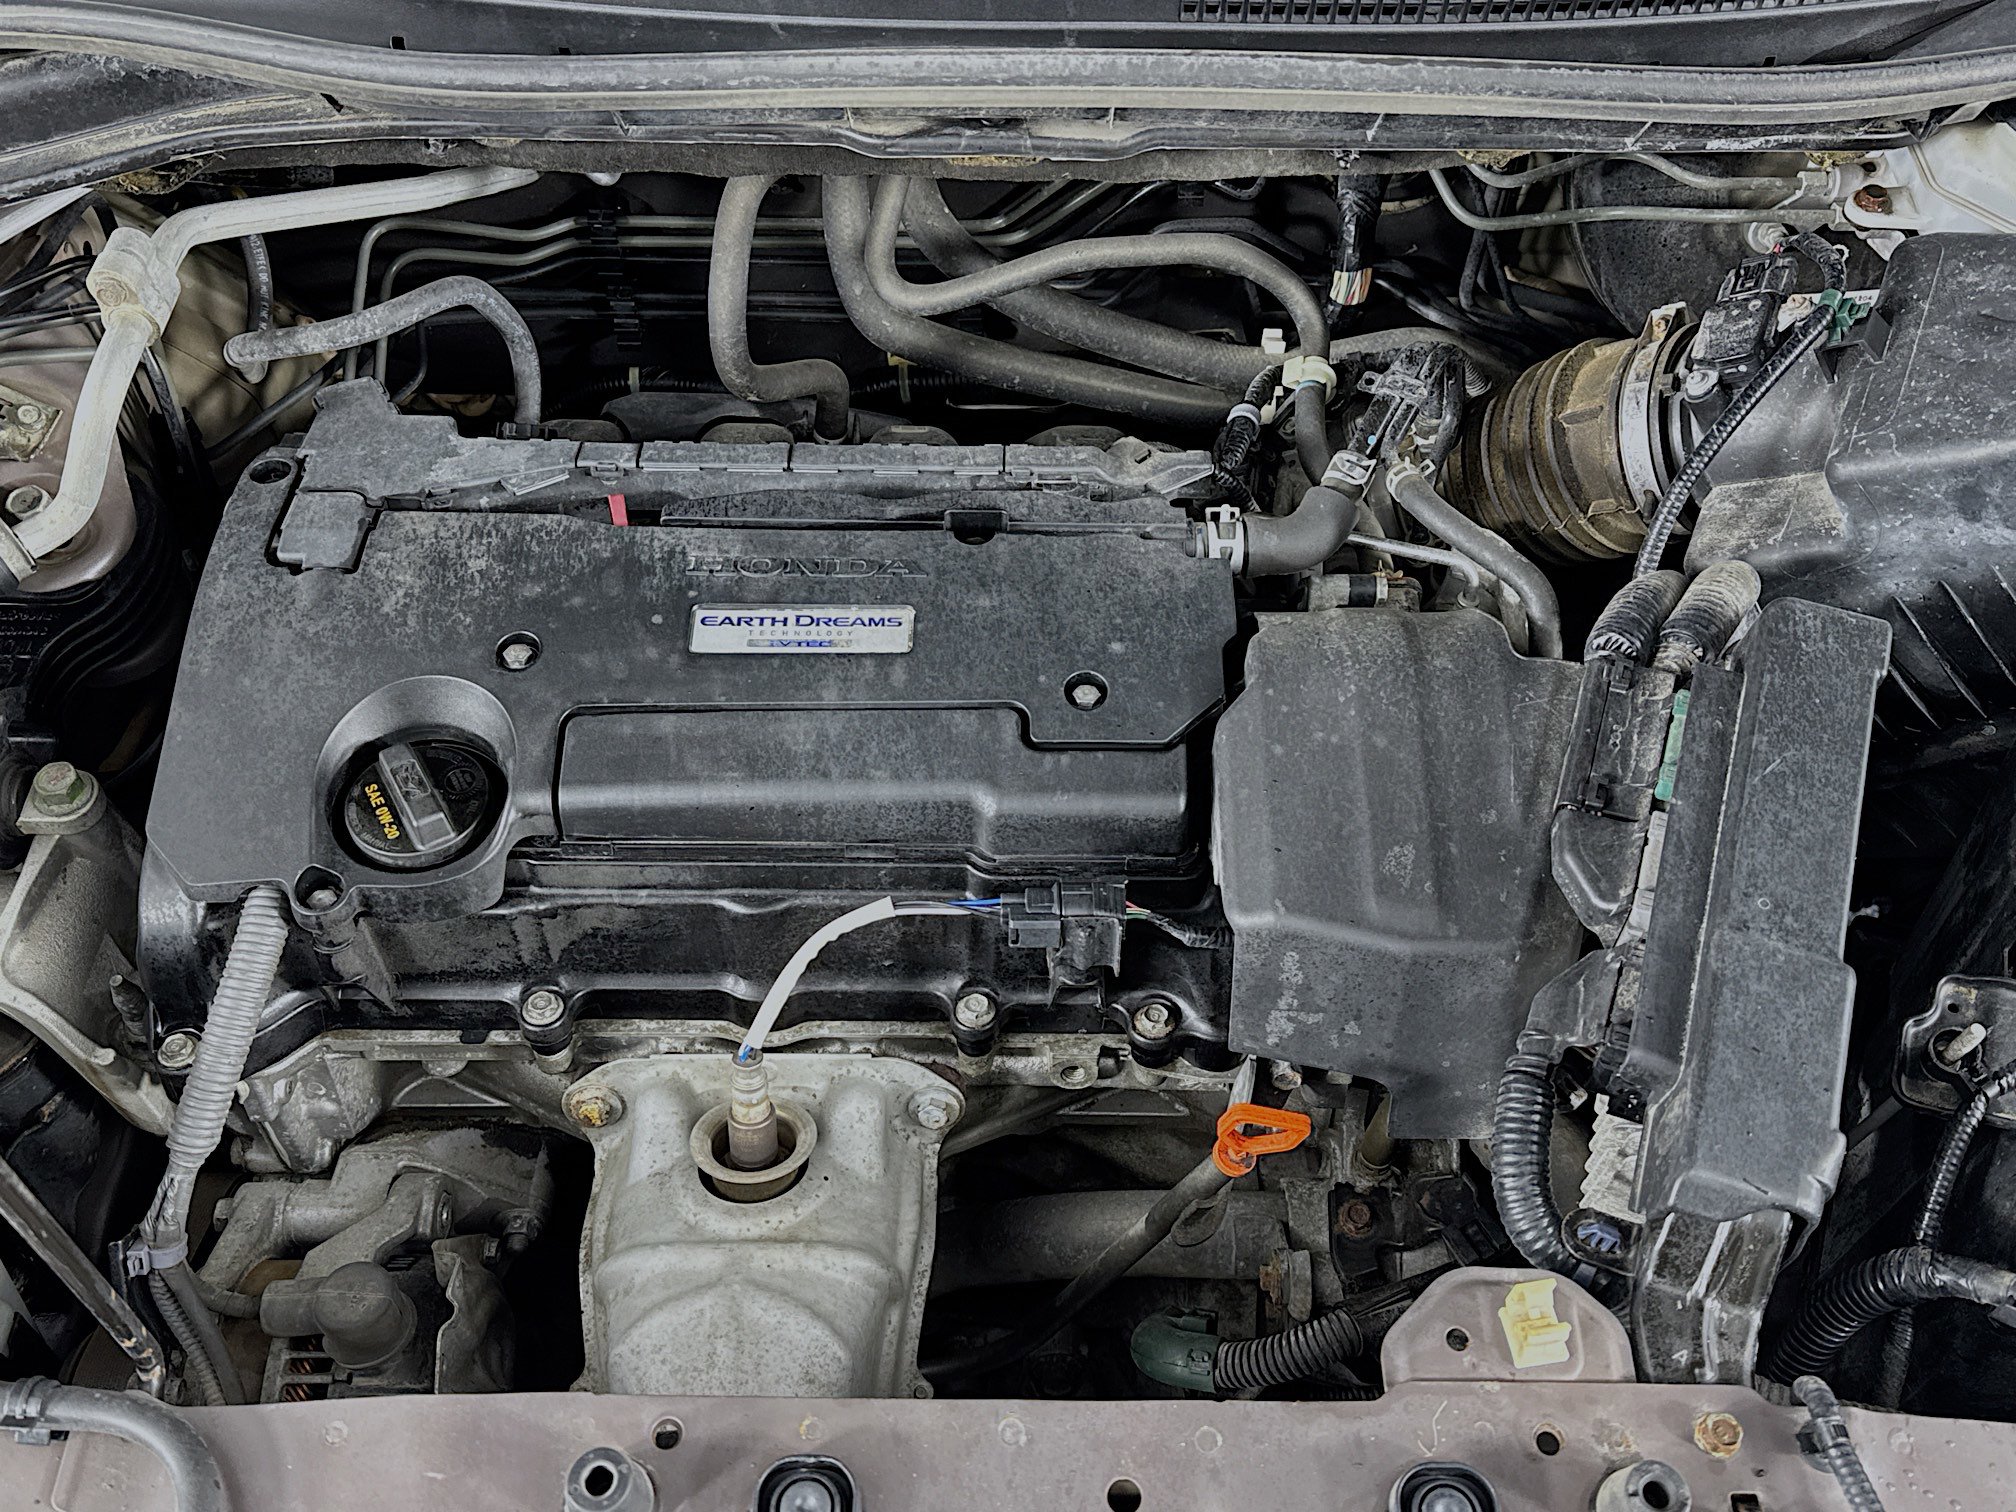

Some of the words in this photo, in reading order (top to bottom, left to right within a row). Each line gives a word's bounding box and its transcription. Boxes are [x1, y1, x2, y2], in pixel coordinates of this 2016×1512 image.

[686, 554, 927, 578] HONDA
[700, 615, 788, 627] EARTH
[795, 614, 903, 627] DREAMS
[748, 629, 854, 637] TECHNOLOGY
[364, 783, 386, 808] SAE
[374, 805, 401, 840] 0W-20
